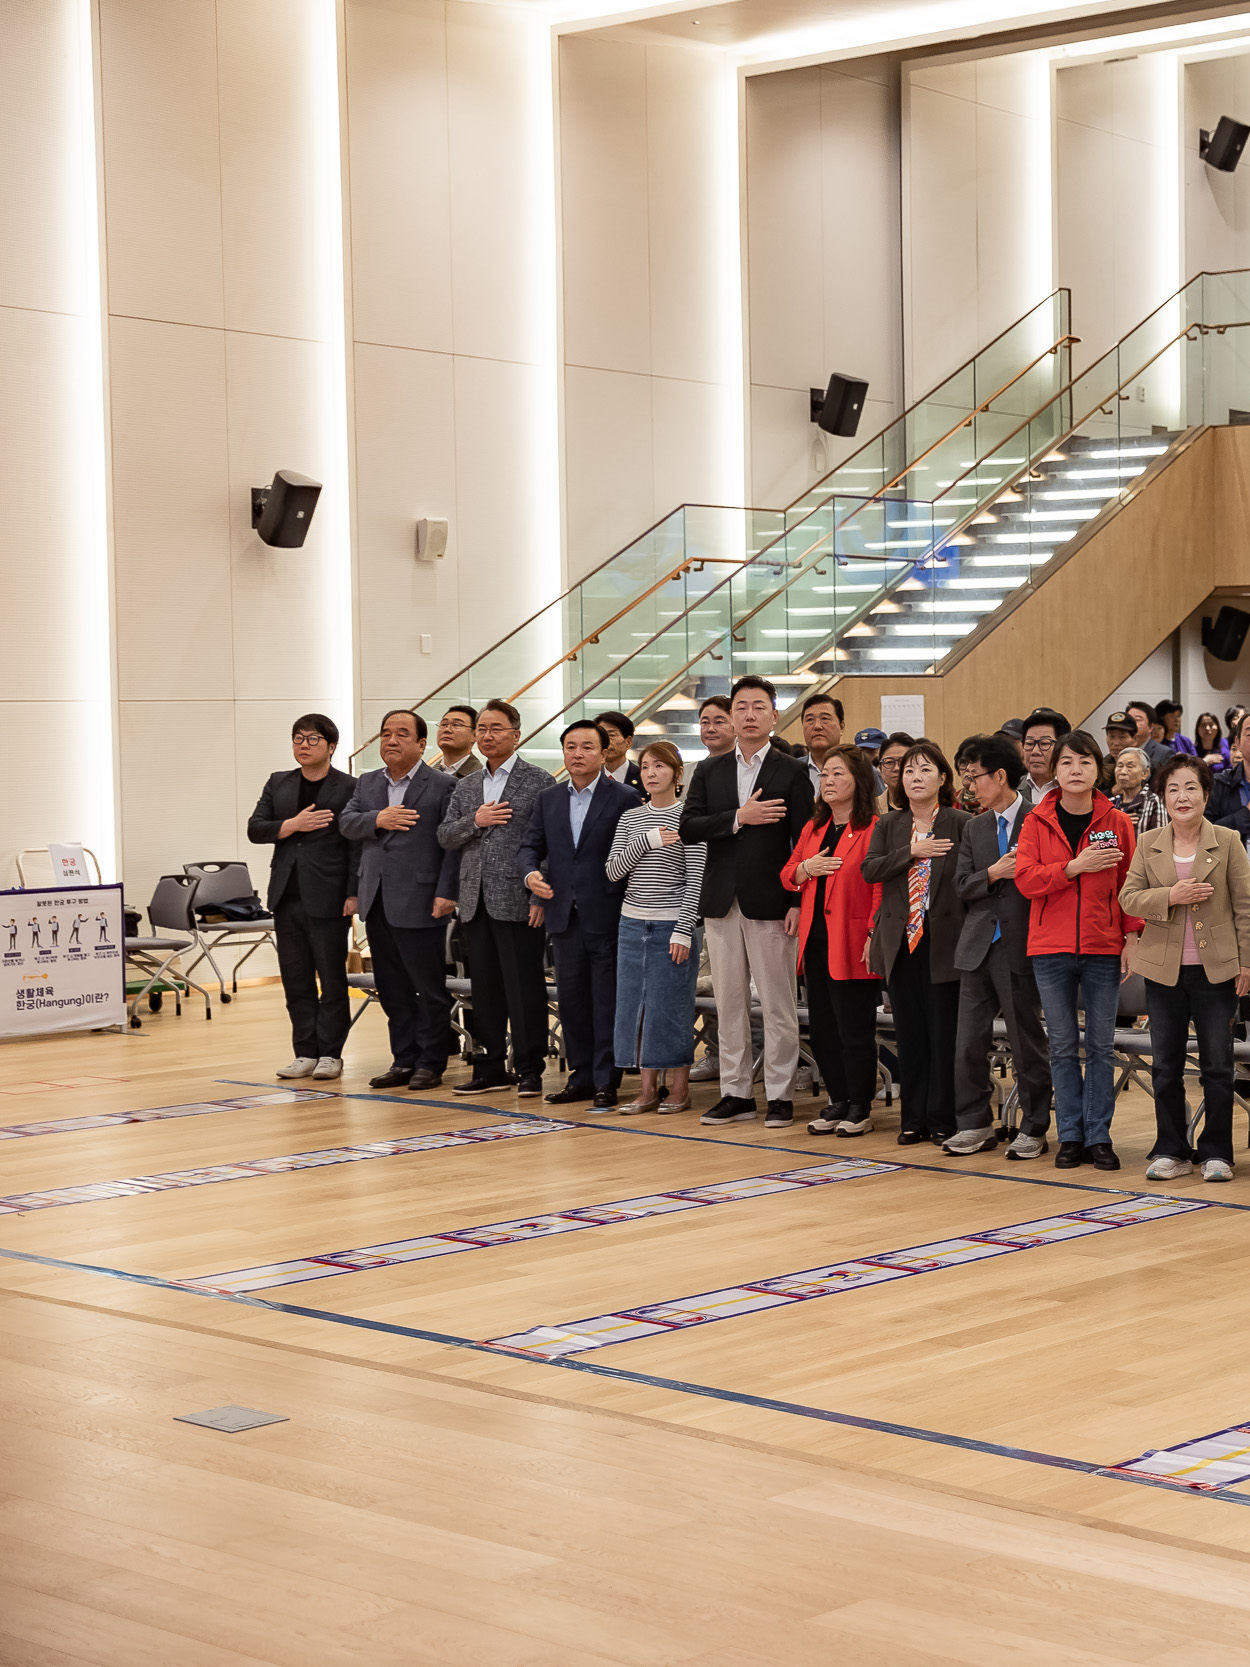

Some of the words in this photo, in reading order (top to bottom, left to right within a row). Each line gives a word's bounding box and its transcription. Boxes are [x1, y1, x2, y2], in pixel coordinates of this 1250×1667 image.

[61, 858, 76, 867] 한궁
[16, 986, 55, 999] 생활체육
[16, 993, 110, 1011] 한궁(Hangung)이란?
